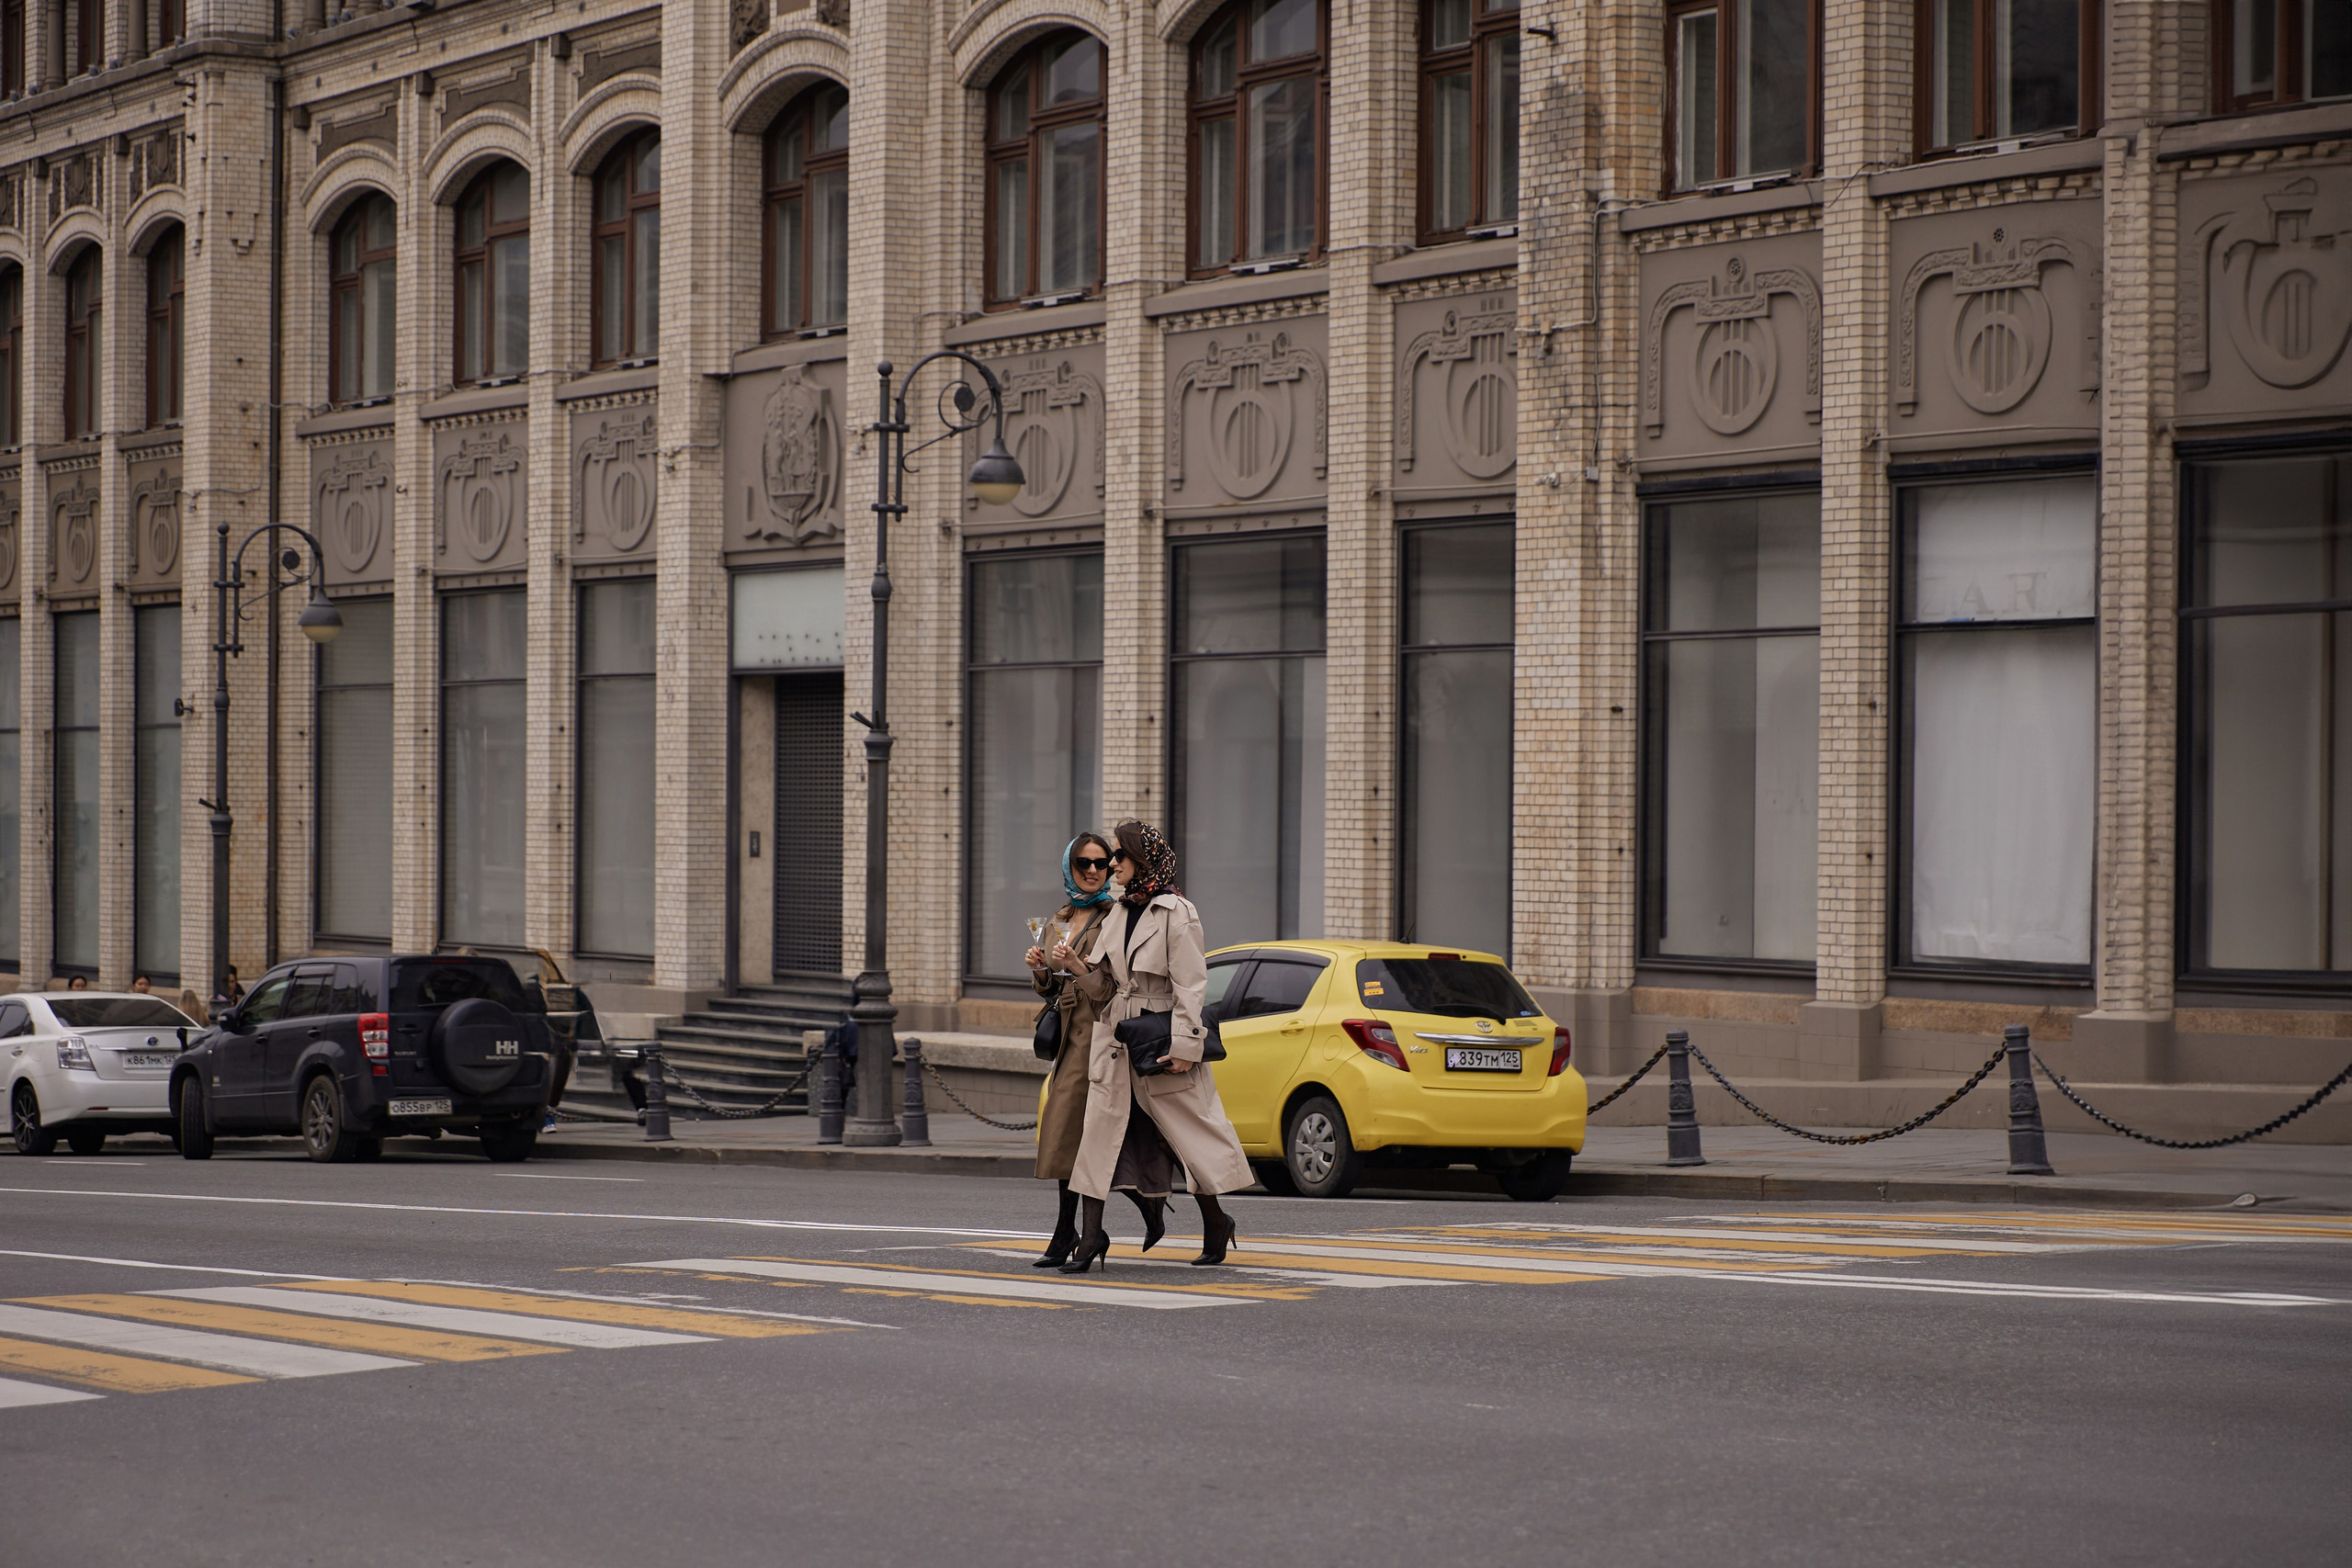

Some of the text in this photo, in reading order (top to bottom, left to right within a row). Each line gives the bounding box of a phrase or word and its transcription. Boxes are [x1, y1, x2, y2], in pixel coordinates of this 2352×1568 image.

[495, 1040, 519, 1055] HH
[1500, 1052, 1519, 1064] 125
[434, 1100, 449, 1110] 125
